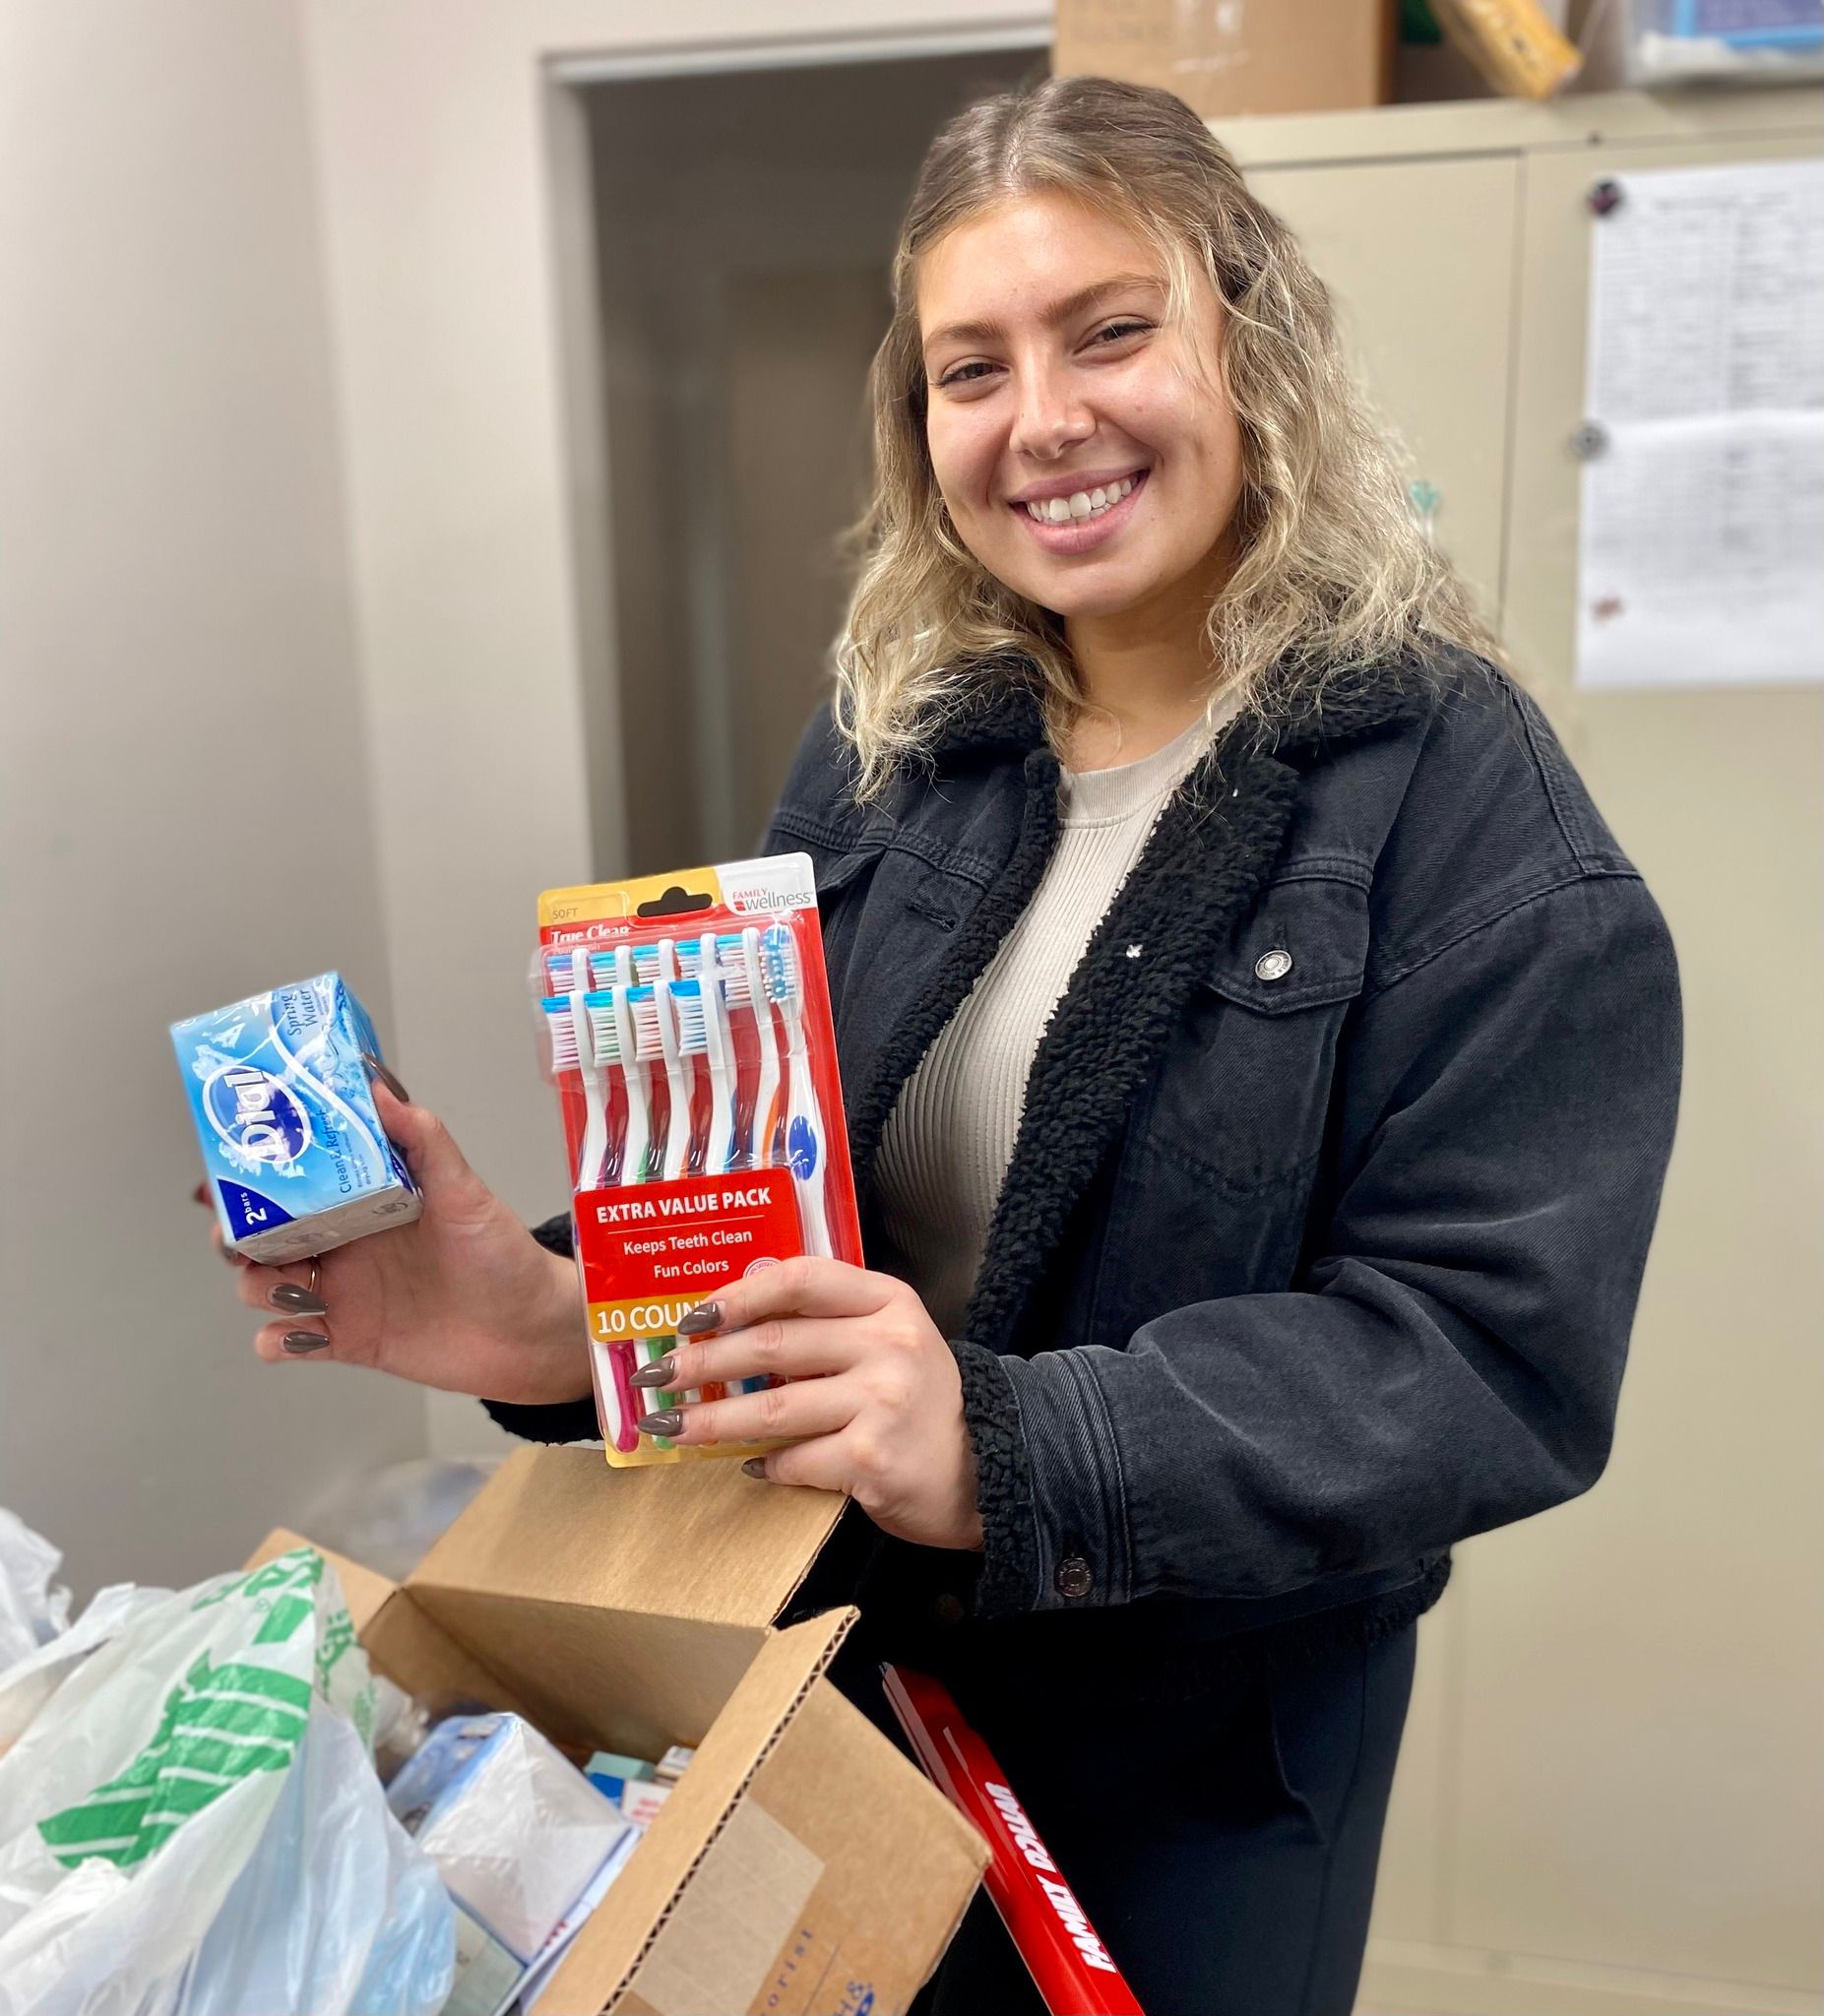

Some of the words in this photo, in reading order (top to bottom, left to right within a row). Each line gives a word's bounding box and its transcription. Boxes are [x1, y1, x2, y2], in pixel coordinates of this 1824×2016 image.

[732, 888, 768, 900] FAMILY
[745, 892, 811, 912] wellness
[552, 908, 579, 920] SOFT
[551, 929, 584, 945] True
[282, 993, 305, 1037] Spring
[300, 989, 319, 1027] Water
[223, 1071, 285, 1161] Dial
[335, 1160, 352, 1194] Clean
[240, 1192, 253, 1215] bars
[597, 1201, 657, 1224] EXTRA
[658, 1193, 719, 1217] VALUE
[722, 1187, 772, 1210] PACK
[245, 1207, 268, 1226] 2
[623, 1240, 666, 1255] Keeps
[668, 1235, 709, 1251] Teeth
[711, 1229, 753, 1246] Clean
[654, 1264, 680, 1279] Fun
[683, 1258, 729, 1276] Colors
[597, 1309, 626, 1334] 10
[984, 1781, 1057, 1873] DOLLAR
[1036, 1873, 1117, 1974] FAMILY
